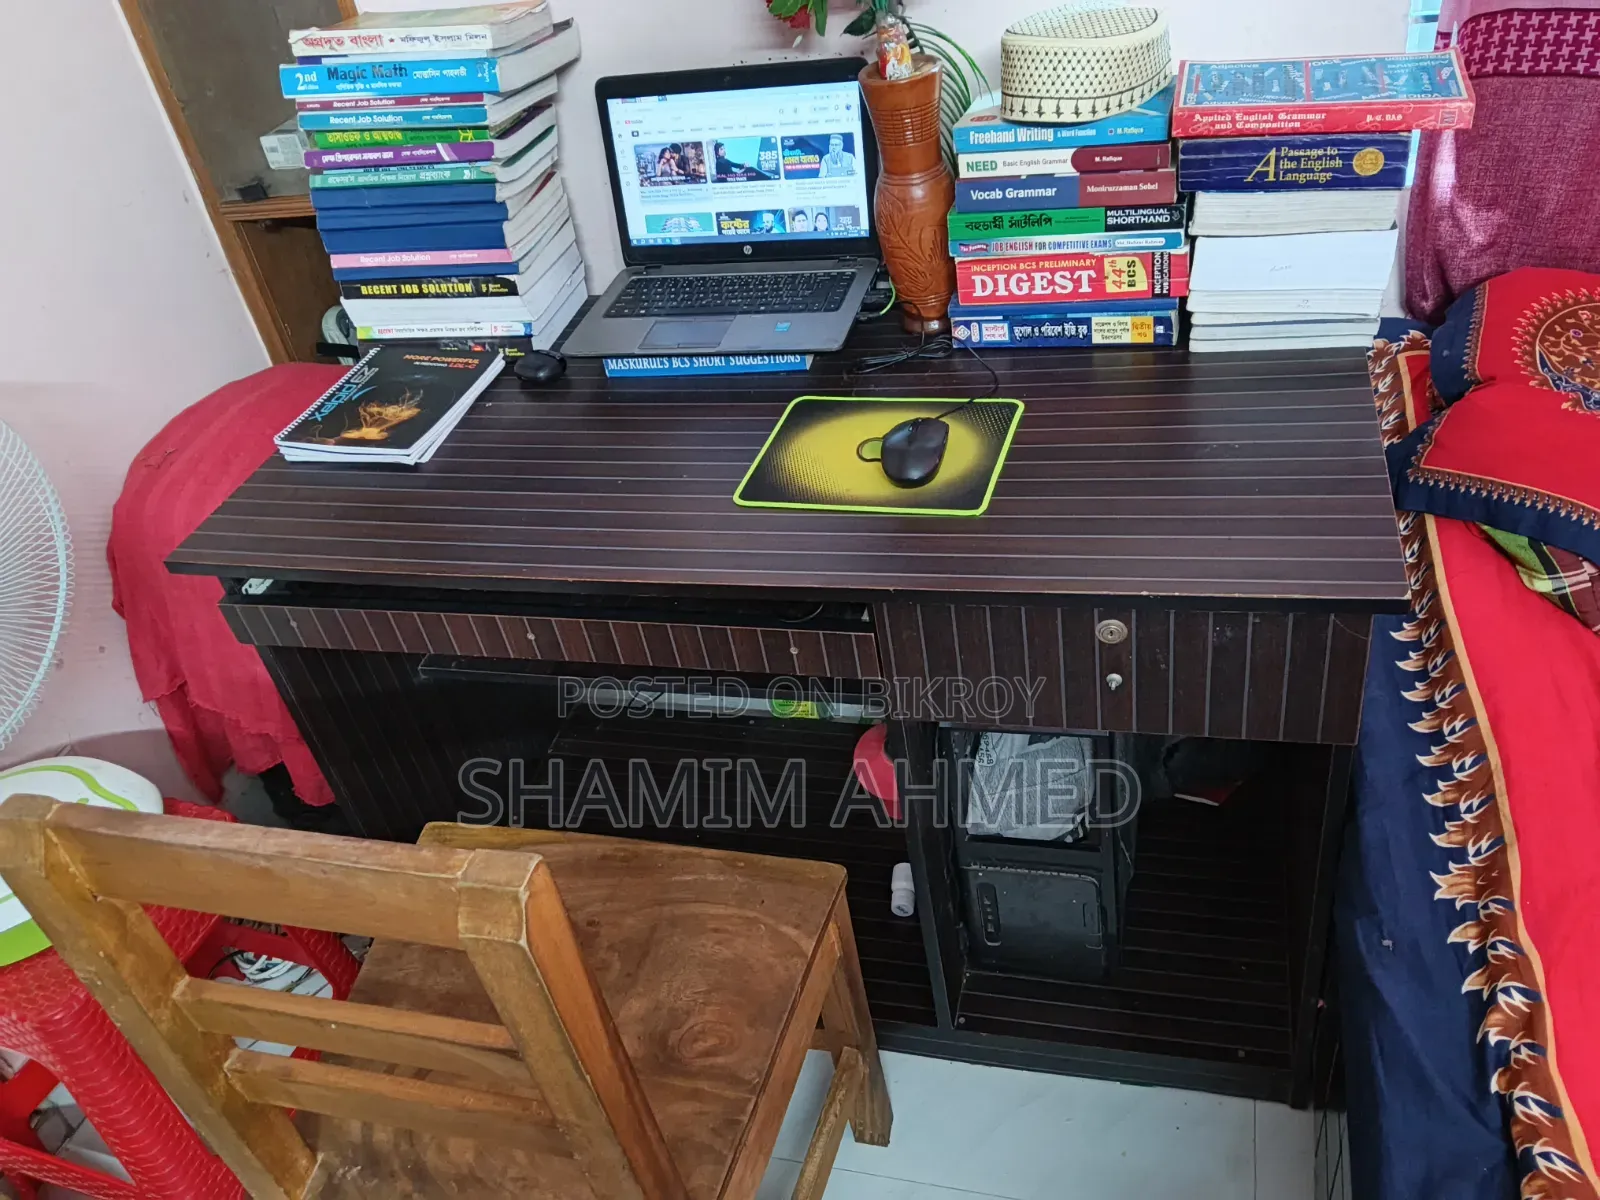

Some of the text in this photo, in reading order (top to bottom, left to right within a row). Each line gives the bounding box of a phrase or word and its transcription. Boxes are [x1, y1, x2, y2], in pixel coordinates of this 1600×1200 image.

[301, 34, 384, 51] অগ্রদূত বাংলা
[327, 63, 408, 83] Magic Math
[295, 71, 317, 90] 2nd
[333, 100, 355, 108] Recent
[329, 116, 355, 124] Recent
[1193, 111, 1327, 123] Applied English Grammar
[1385, 113, 1403, 121] DAS
[1123, 127, 1144, 135] Rafique
[1214, 120, 1301, 130] and Composition
[969, 127, 1054, 145] Freehand Writing
[759, 150, 778, 160] 385
[1102, 155, 1123, 163] Rafique
[1280, 146, 1338, 159] Passage to
[966, 156, 1068, 172] NEED Basic English Grammar
[1243, 147, 1277, 182] A
[1279, 157, 1343, 171] the English
[1279, 171, 1333, 183] Language
[970, 186, 1057, 200] Vocab Grammar
[1086, 182, 1158, 193] Moniruzzaman Sohel
[1107, 207, 1170, 216] MULTILINGUAL
[965, 215, 1005, 232] বহুভাষী
[1008, 213, 1053, 229] সাঁটলিপি
[1106, 215, 1170, 225] SHORTHAND
[992, 239, 1112, 251] JOB ENGLISH FOR COMPETITIVE EXAMS
[401, 254, 431, 262] Solution
[971, 258, 1097, 272] INCEPTION BCS PRELIMINARY
[1111, 258, 1127, 290] 44th
[1127, 259, 1137, 288] BCS
[1154, 252, 1162, 294] INCEPTION
[361, 285, 397, 295] RECENT
[401, 284, 419, 294] JOB
[422, 283, 473, 294] SOLUTION
[971, 270, 1097, 297] DIGEST
[1013, 321, 1088, 341] ভূগোল ও পরিবেশ ইজি বুক
[431, 356, 479, 364] POWERFUL
[672, 356, 690, 369] BCS
[729, 355, 801, 366] SUGGESTIONS
